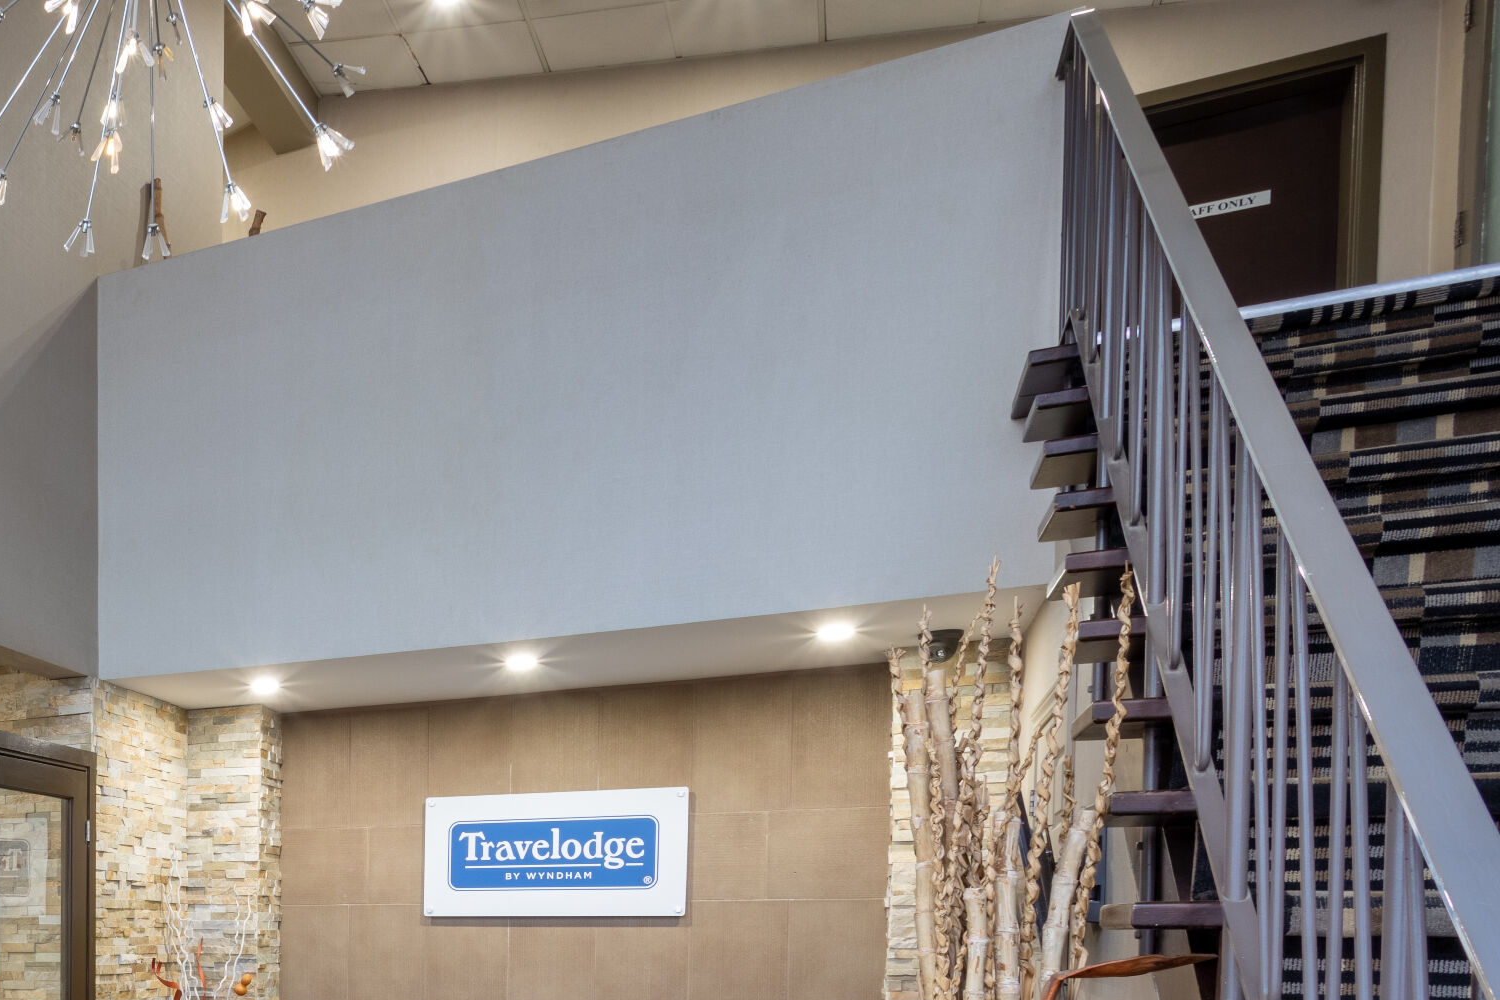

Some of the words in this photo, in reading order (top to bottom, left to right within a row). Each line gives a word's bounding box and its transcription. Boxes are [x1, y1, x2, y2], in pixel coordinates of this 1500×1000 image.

[1190, 204, 1214, 216] AFF
[1218, 195, 1257, 211] ONLY
[458, 828, 645, 870] Travelodge
[505, 872, 521, 881] BY
[526, 871, 593, 880] WYNDHAM
